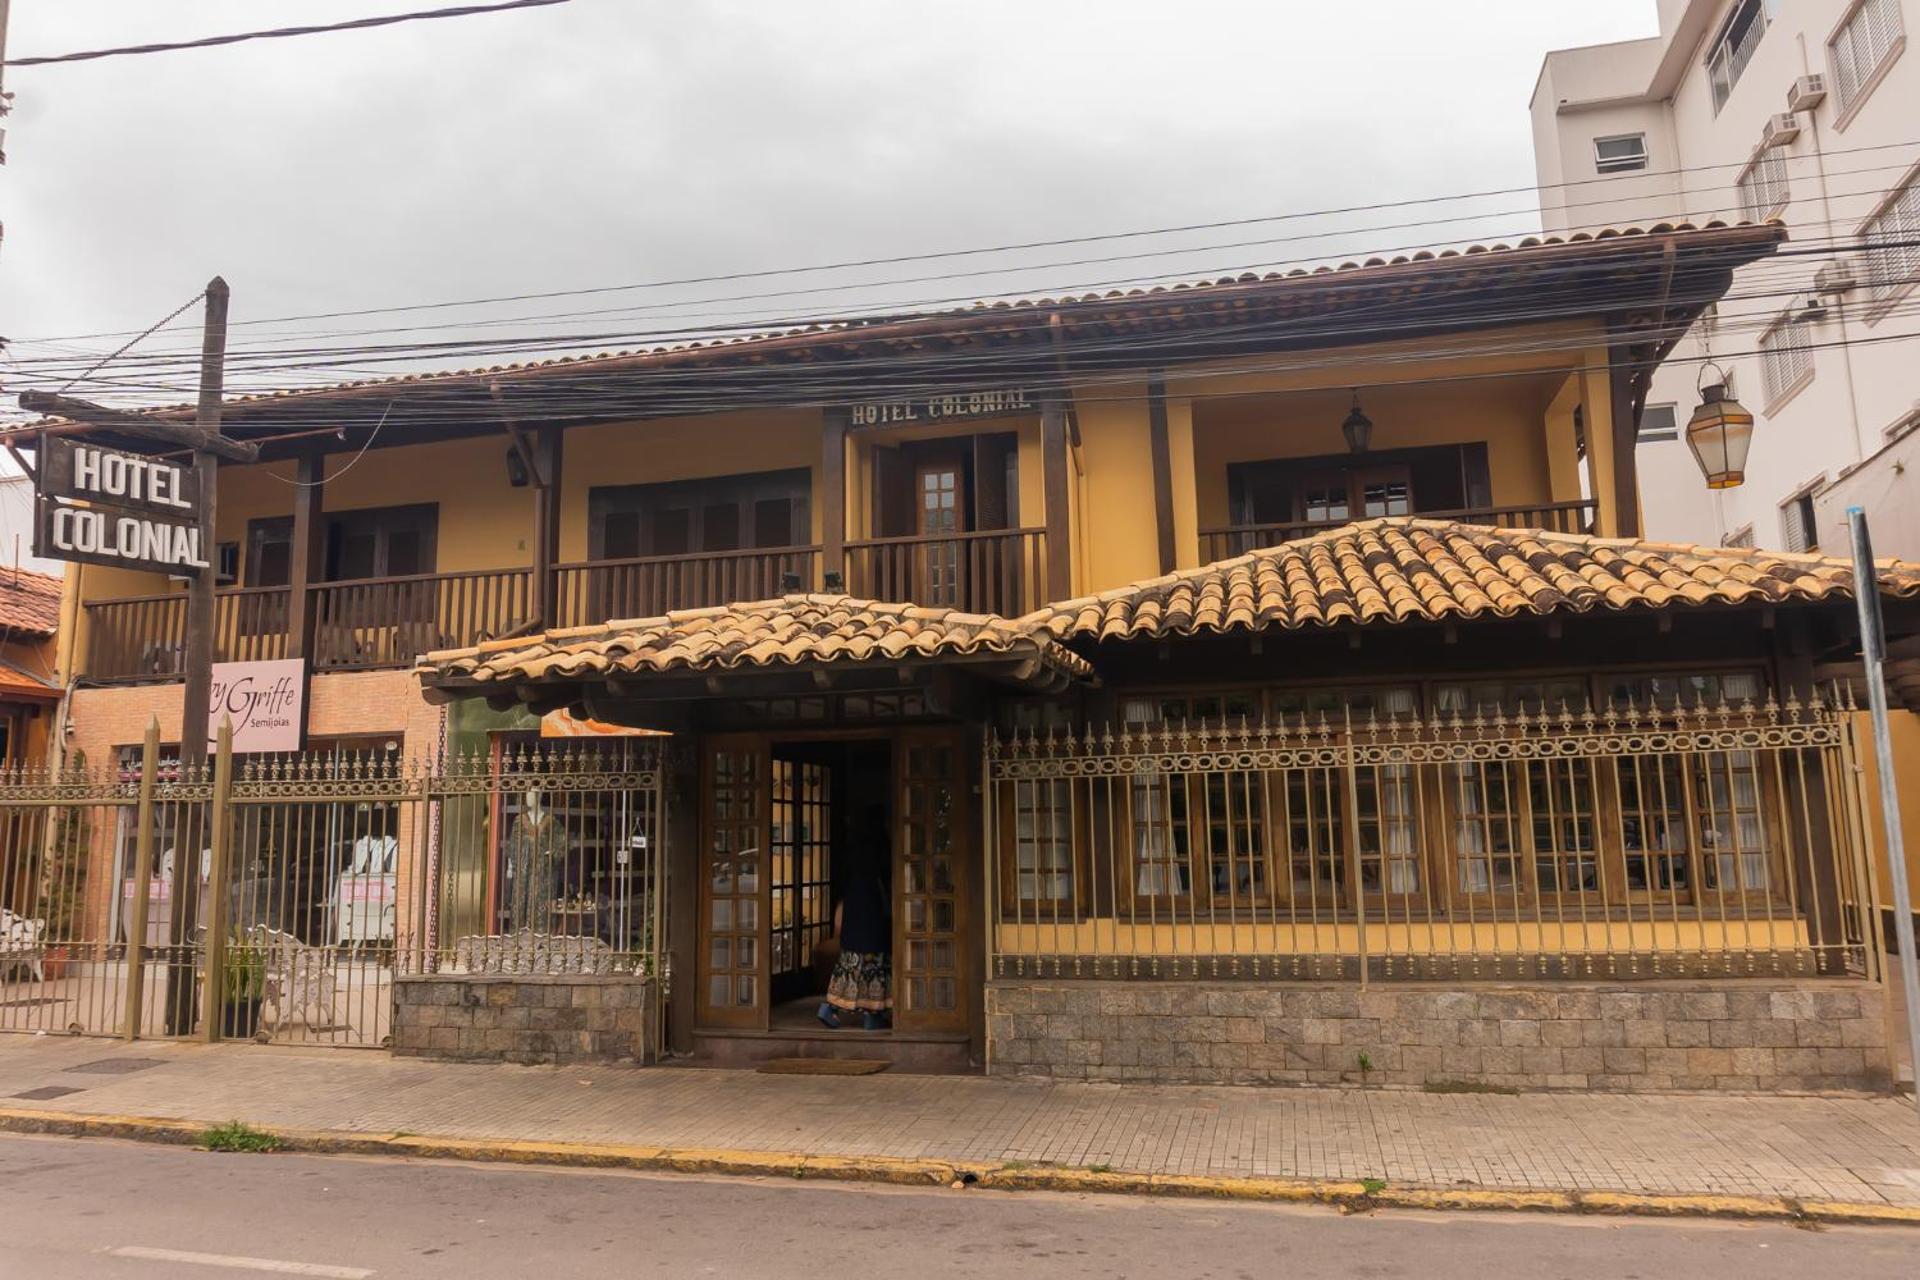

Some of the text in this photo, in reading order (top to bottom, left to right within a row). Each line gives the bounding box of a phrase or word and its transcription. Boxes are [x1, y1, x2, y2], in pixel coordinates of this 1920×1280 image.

[853, 389, 1032, 425] HOTEL COLONIAL
[74, 448, 191, 508] HOTEL
[53, 508, 210, 568] COLONIAL
[226, 676, 295, 736] Griffe
[250, 717, 290, 729] Semijoias
